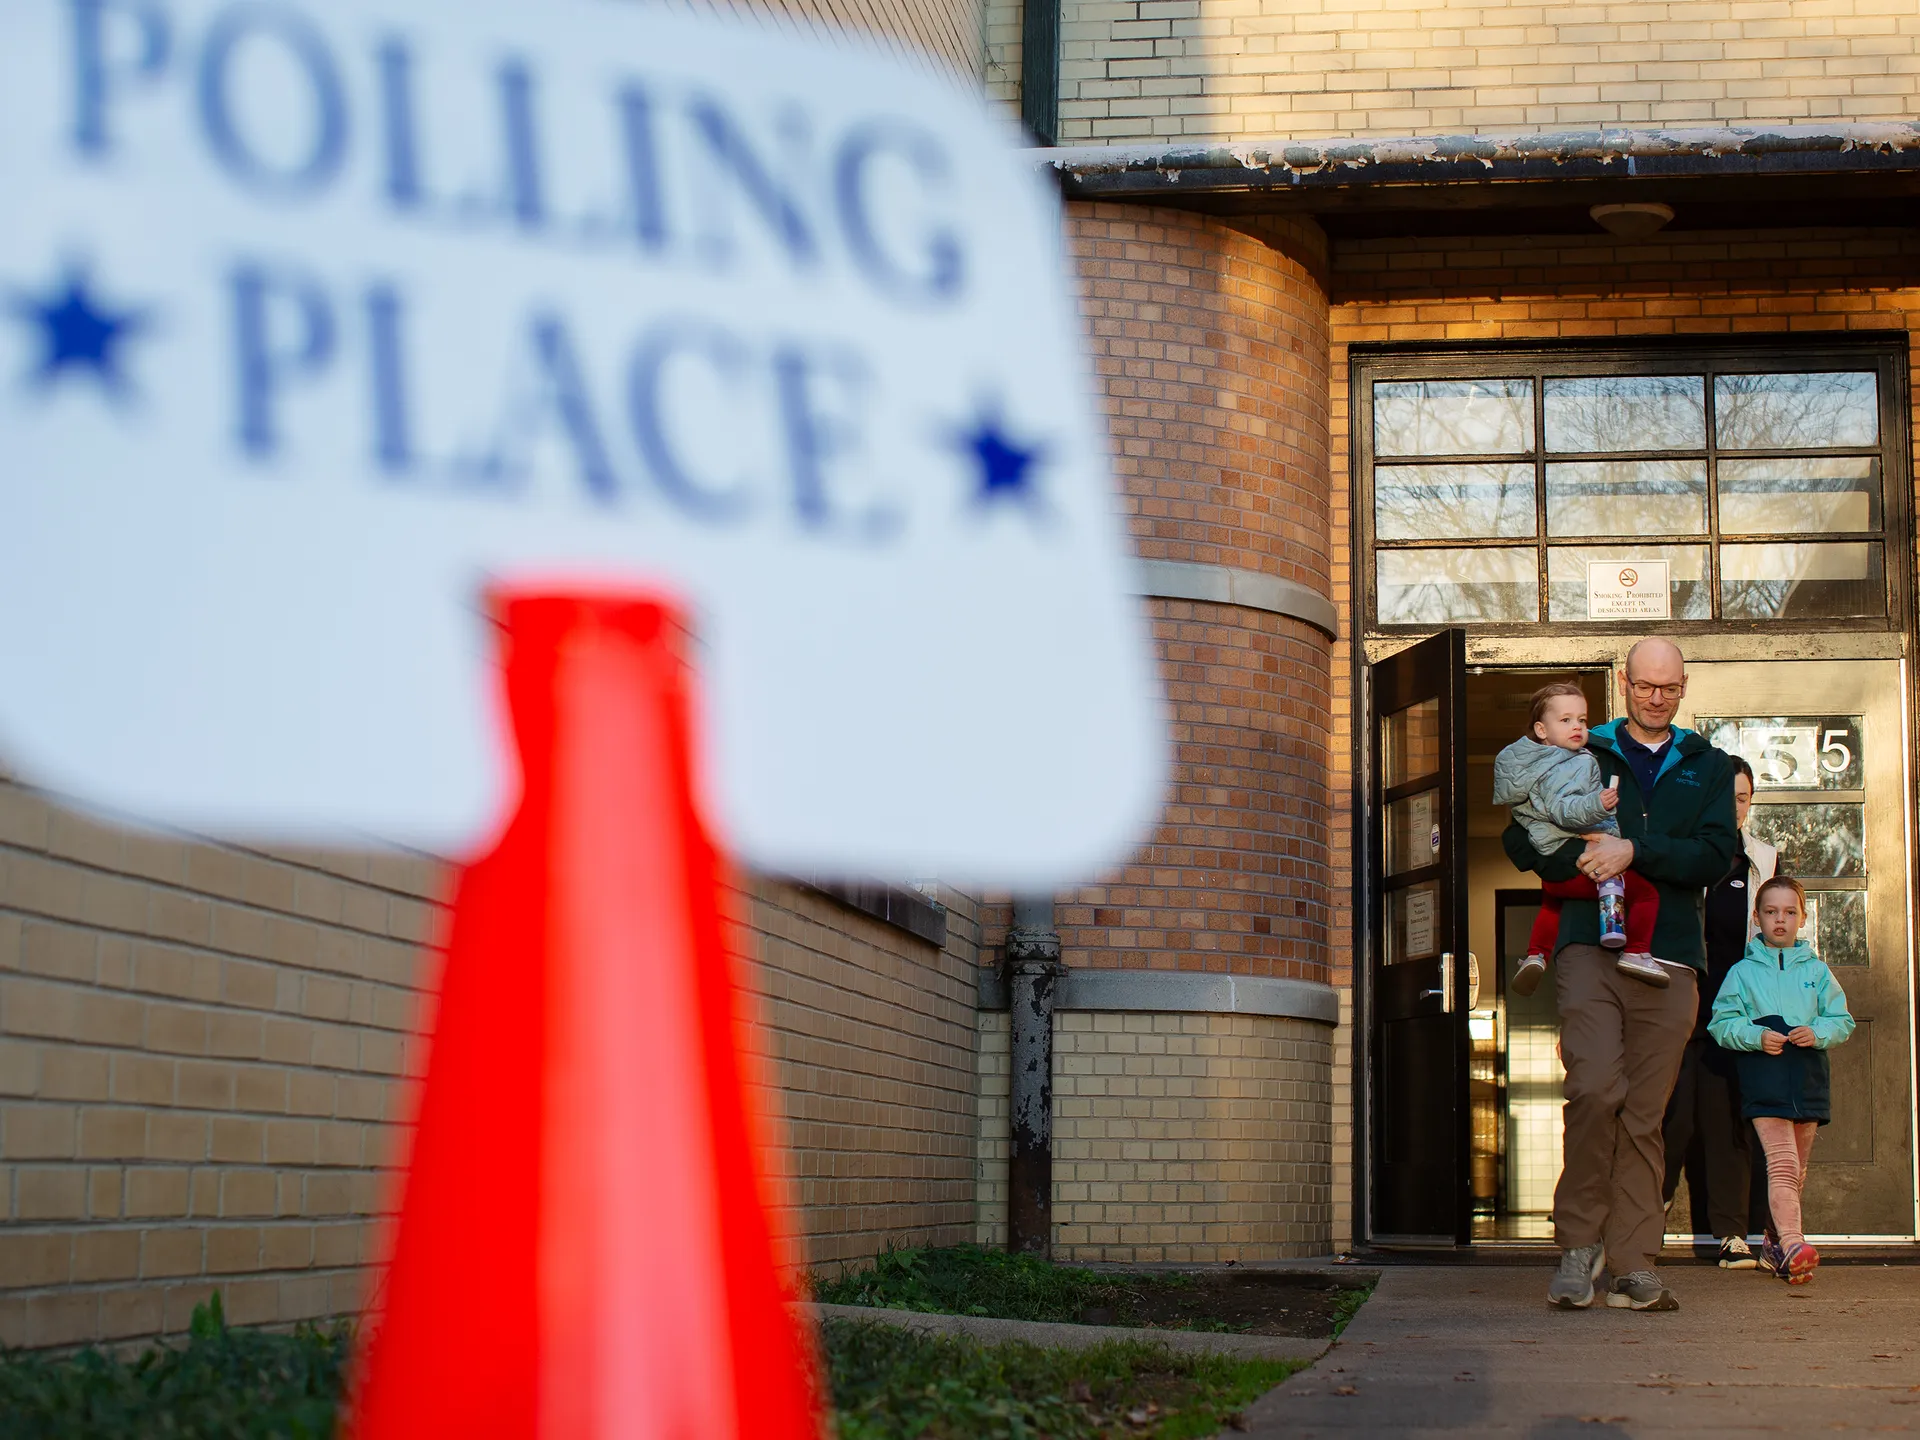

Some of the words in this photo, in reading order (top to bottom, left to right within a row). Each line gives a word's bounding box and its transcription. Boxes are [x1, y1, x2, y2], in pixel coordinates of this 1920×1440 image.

[60, 0, 970, 306] POLLING
[220, 247, 907, 545] PLACE
[1594, 591, 1622, 599] SMOKING
[1626, 590, 1663, 599] PROHIBITED
[1821, 729, 1851, 773] 5
